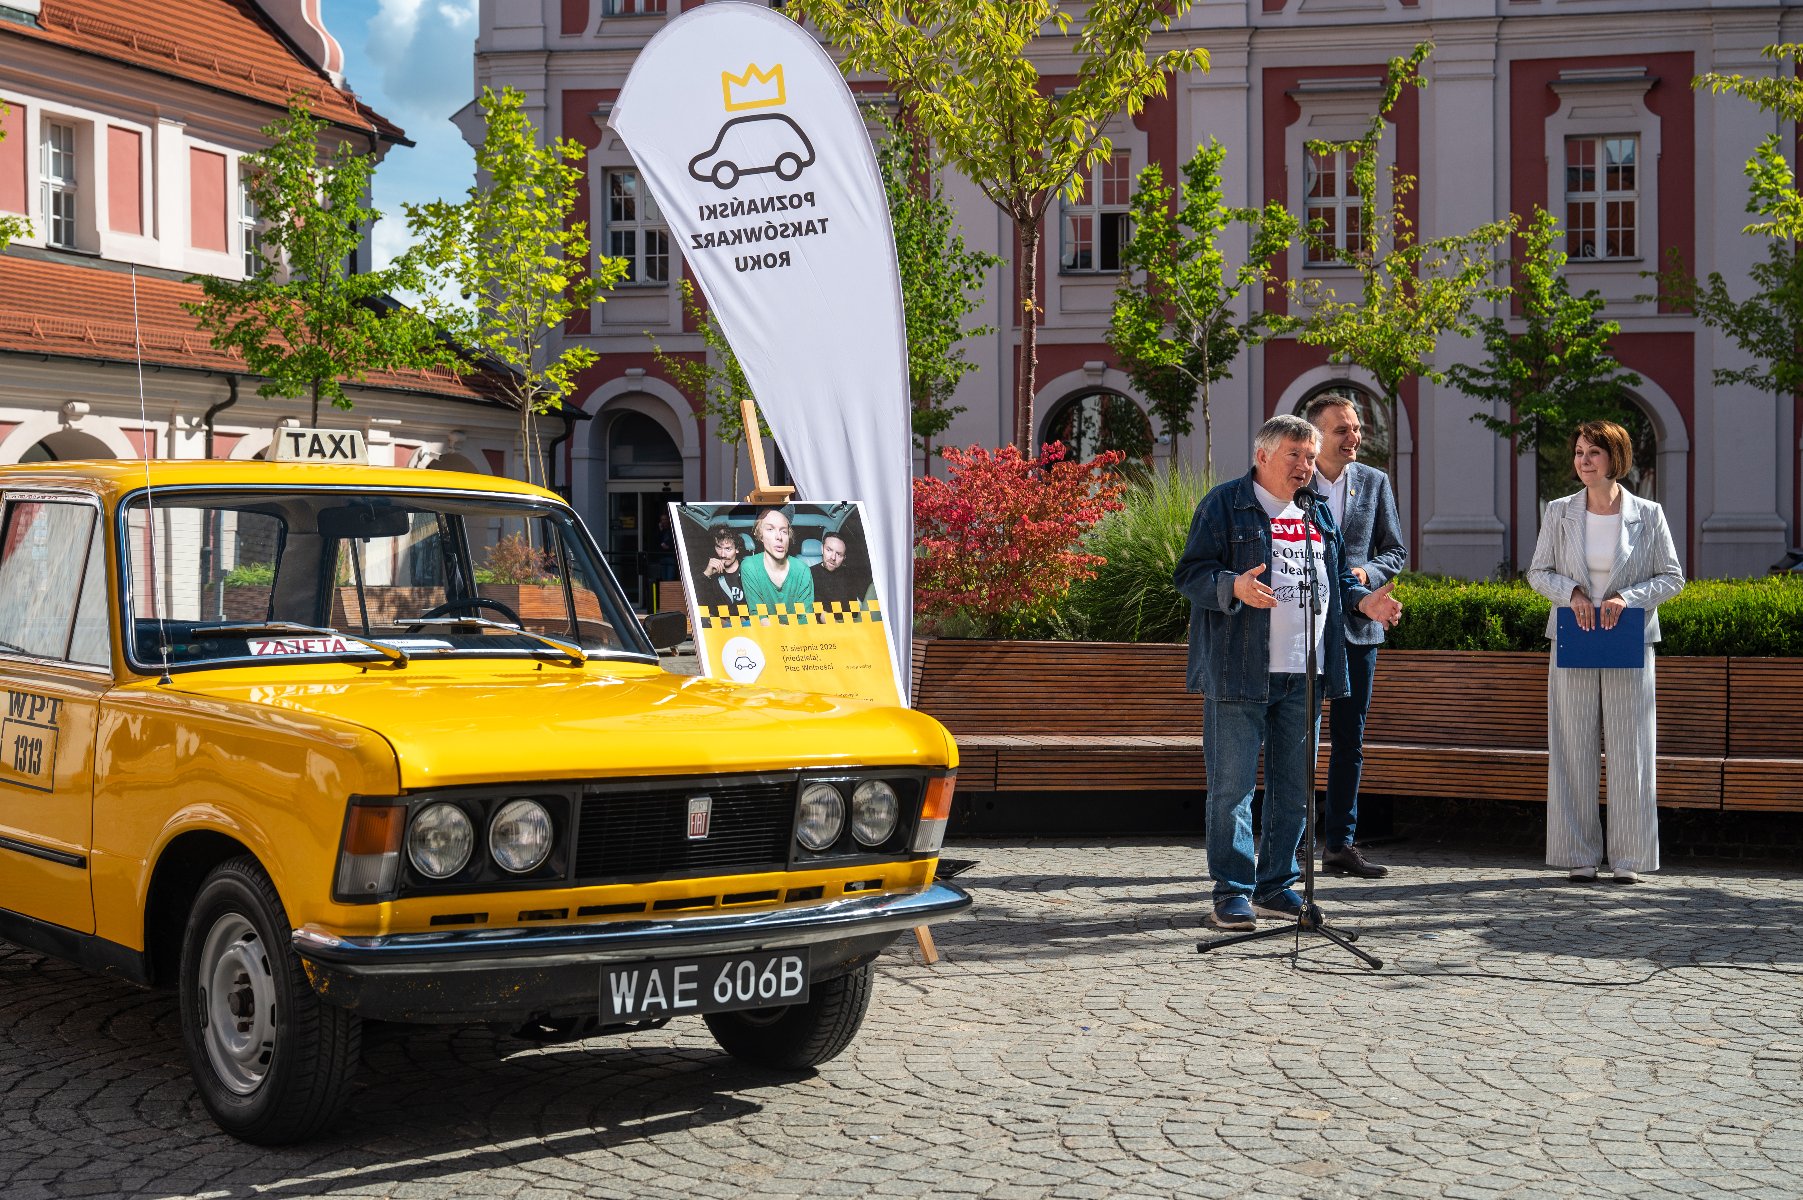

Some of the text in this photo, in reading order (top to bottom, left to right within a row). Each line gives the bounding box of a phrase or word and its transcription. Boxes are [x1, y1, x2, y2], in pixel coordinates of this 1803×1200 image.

[286, 432, 357, 459] TAXI
[790, 644, 818, 653] sierpnia
[8, 690, 63, 724] WPT
[14, 734, 43, 775] 1313
[690, 812, 708, 835] FIAT
[609, 955, 804, 1015] WAE 606B
